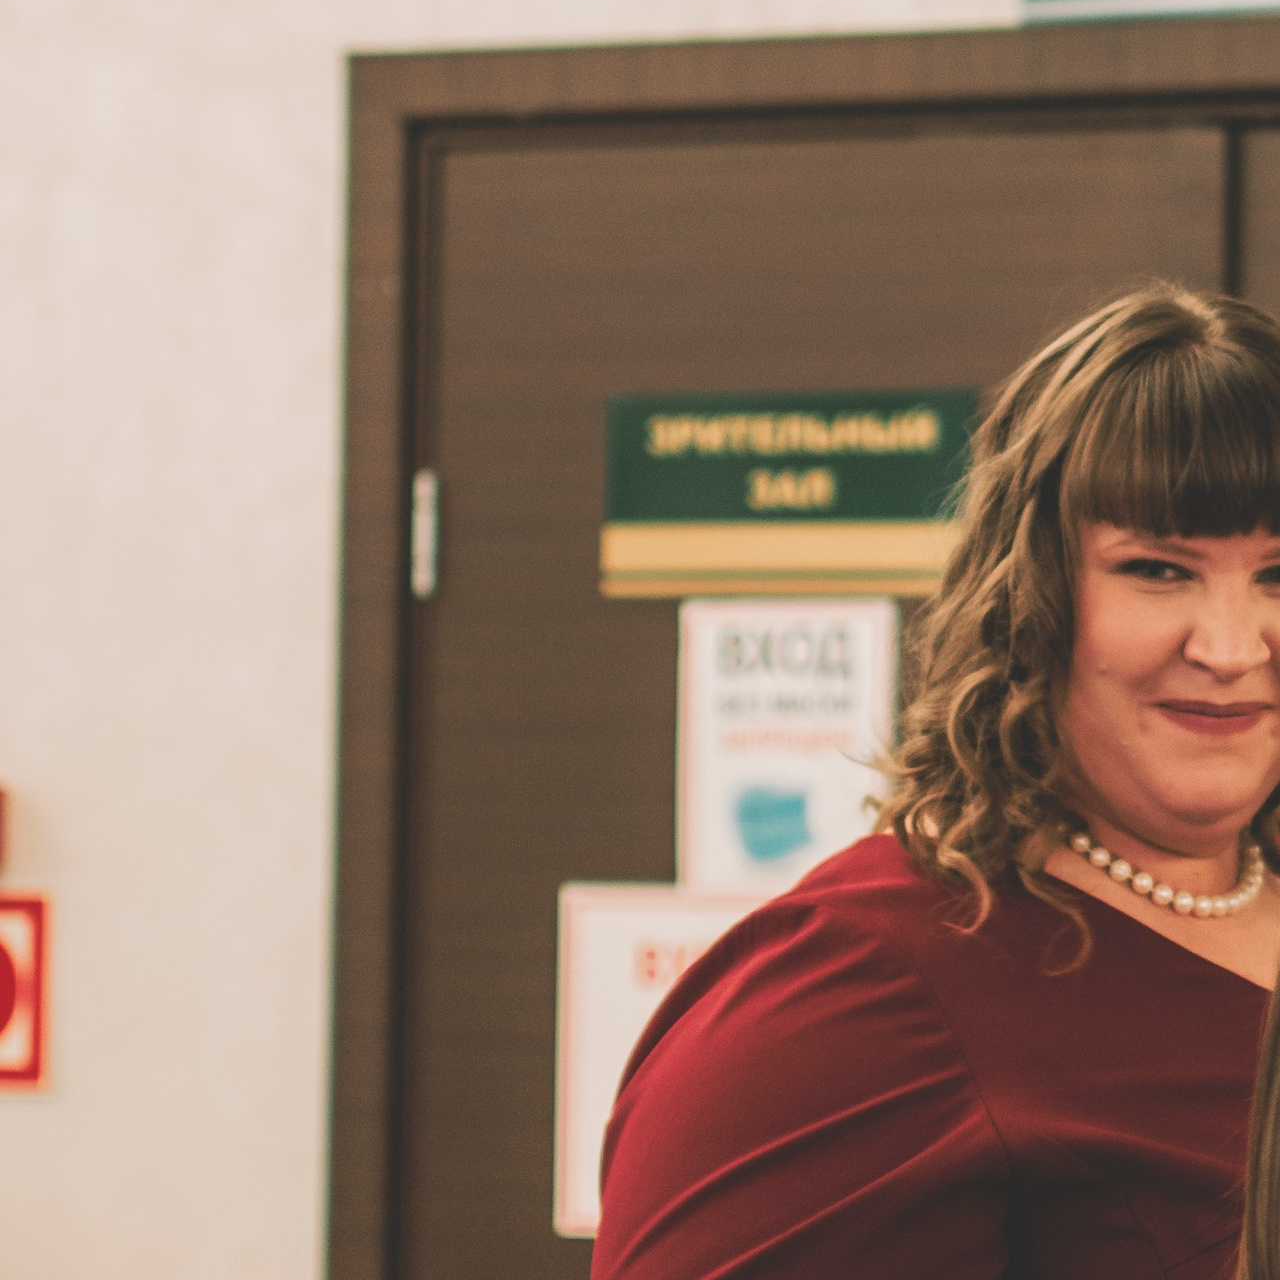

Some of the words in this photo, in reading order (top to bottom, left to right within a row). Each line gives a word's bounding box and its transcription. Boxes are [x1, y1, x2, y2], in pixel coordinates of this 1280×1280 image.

[650, 410, 937, 455] ЗРИТЕЛЬНЫЙ
[749, 467, 833, 510] ЗАЛ
[719, 625, 854, 681] ВХОД
